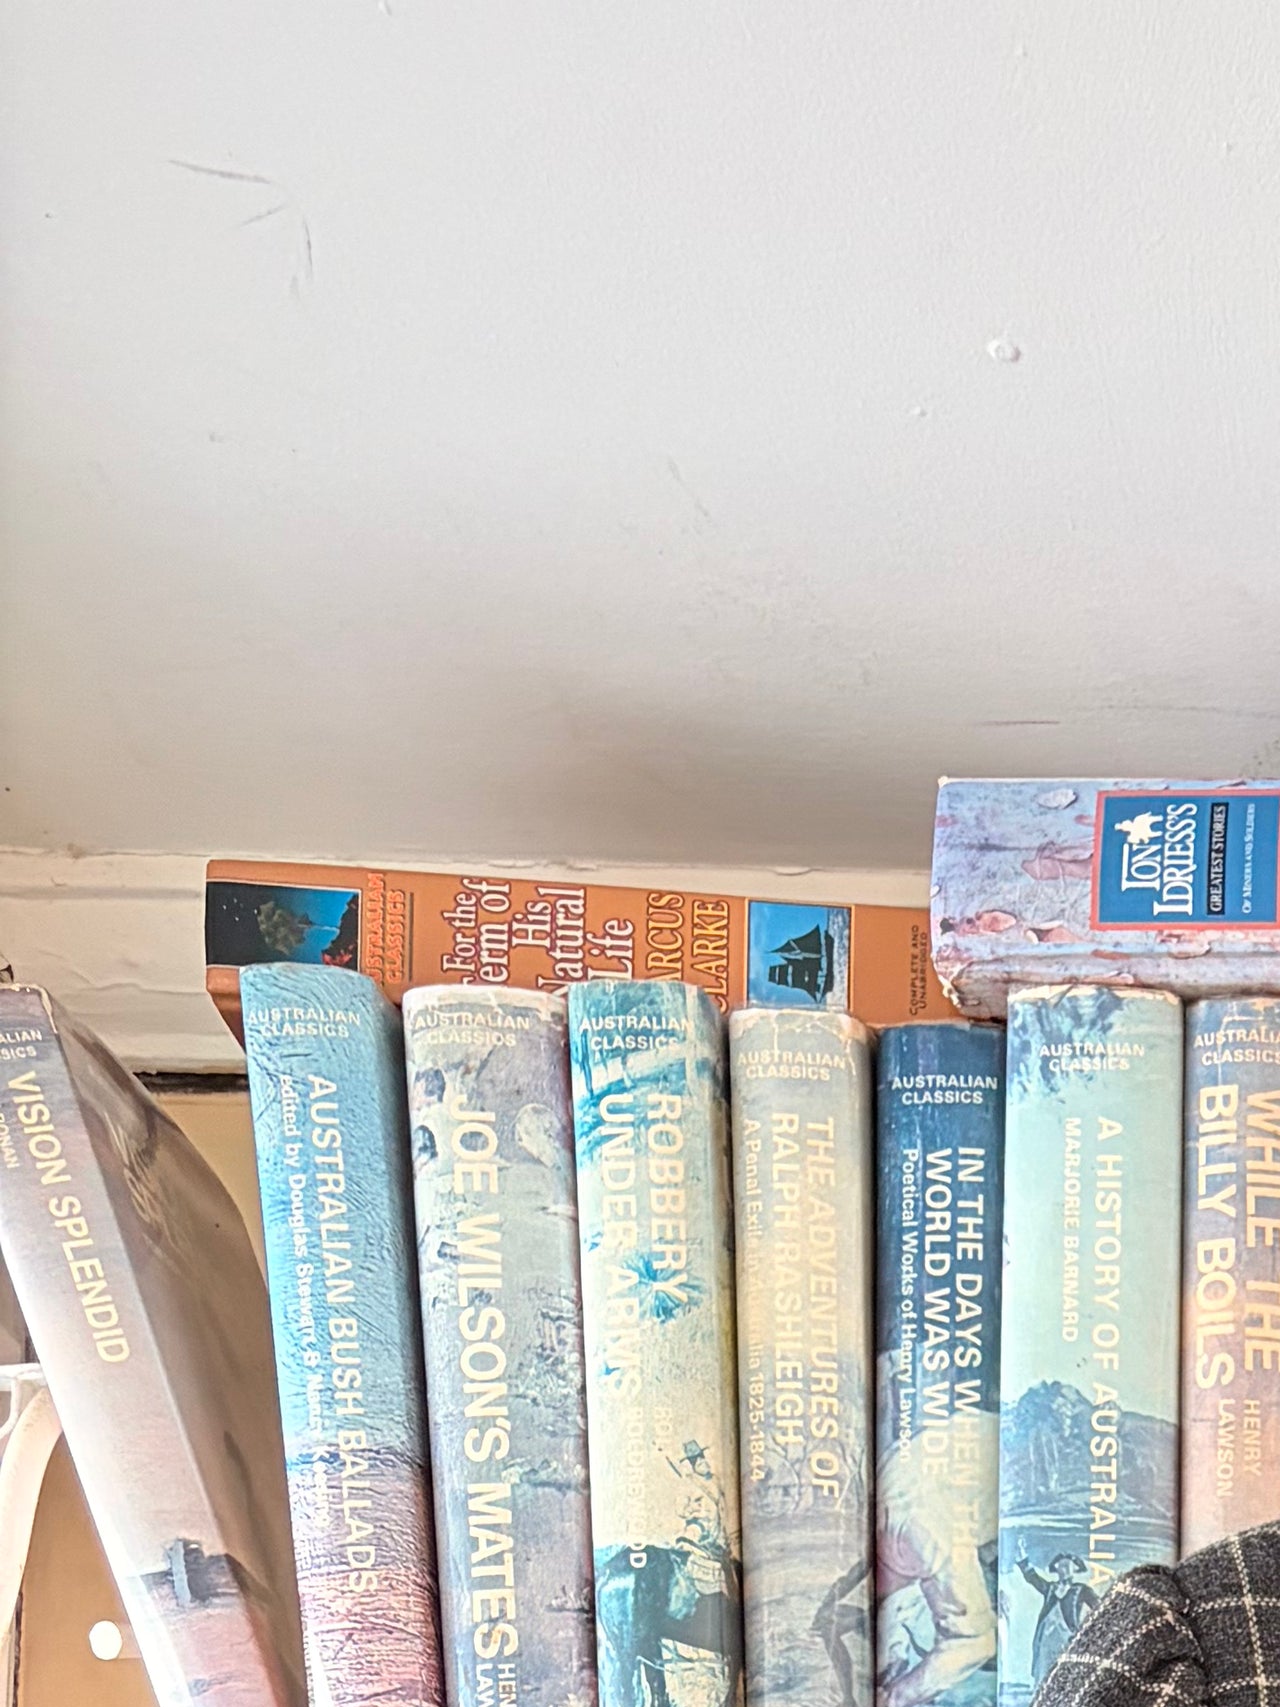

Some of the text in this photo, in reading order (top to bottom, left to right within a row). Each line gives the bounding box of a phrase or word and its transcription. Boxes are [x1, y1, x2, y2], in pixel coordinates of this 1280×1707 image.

[1153, 803, 1198, 916] IDRIESS'S
[1210, 804, 1226, 912] GREATEST STORIES
[247, 1008, 361, 1027] AUSTRALIAN
[891, 1074, 998, 1090] AUSTRALIAN
[901, 1090, 984, 1106] CLASSICS
[8, 1070, 131, 1364] VISION SPLENDID
[599, 1093, 644, 1402] UNDER ARMS
[646, 1093, 690, 1303] ROBBERY
[1194, 1083, 1240, 1391] BILLY BOILS
[308, 1074, 379, 1594] AUSTRALIAN BUSH BALLADS
[448, 1094, 520, 1660] JOE WILSON'S MATES
[1215, 1398, 1237, 1499] LAWSON
[1243, 1399, 1262, 1477] HENRY
